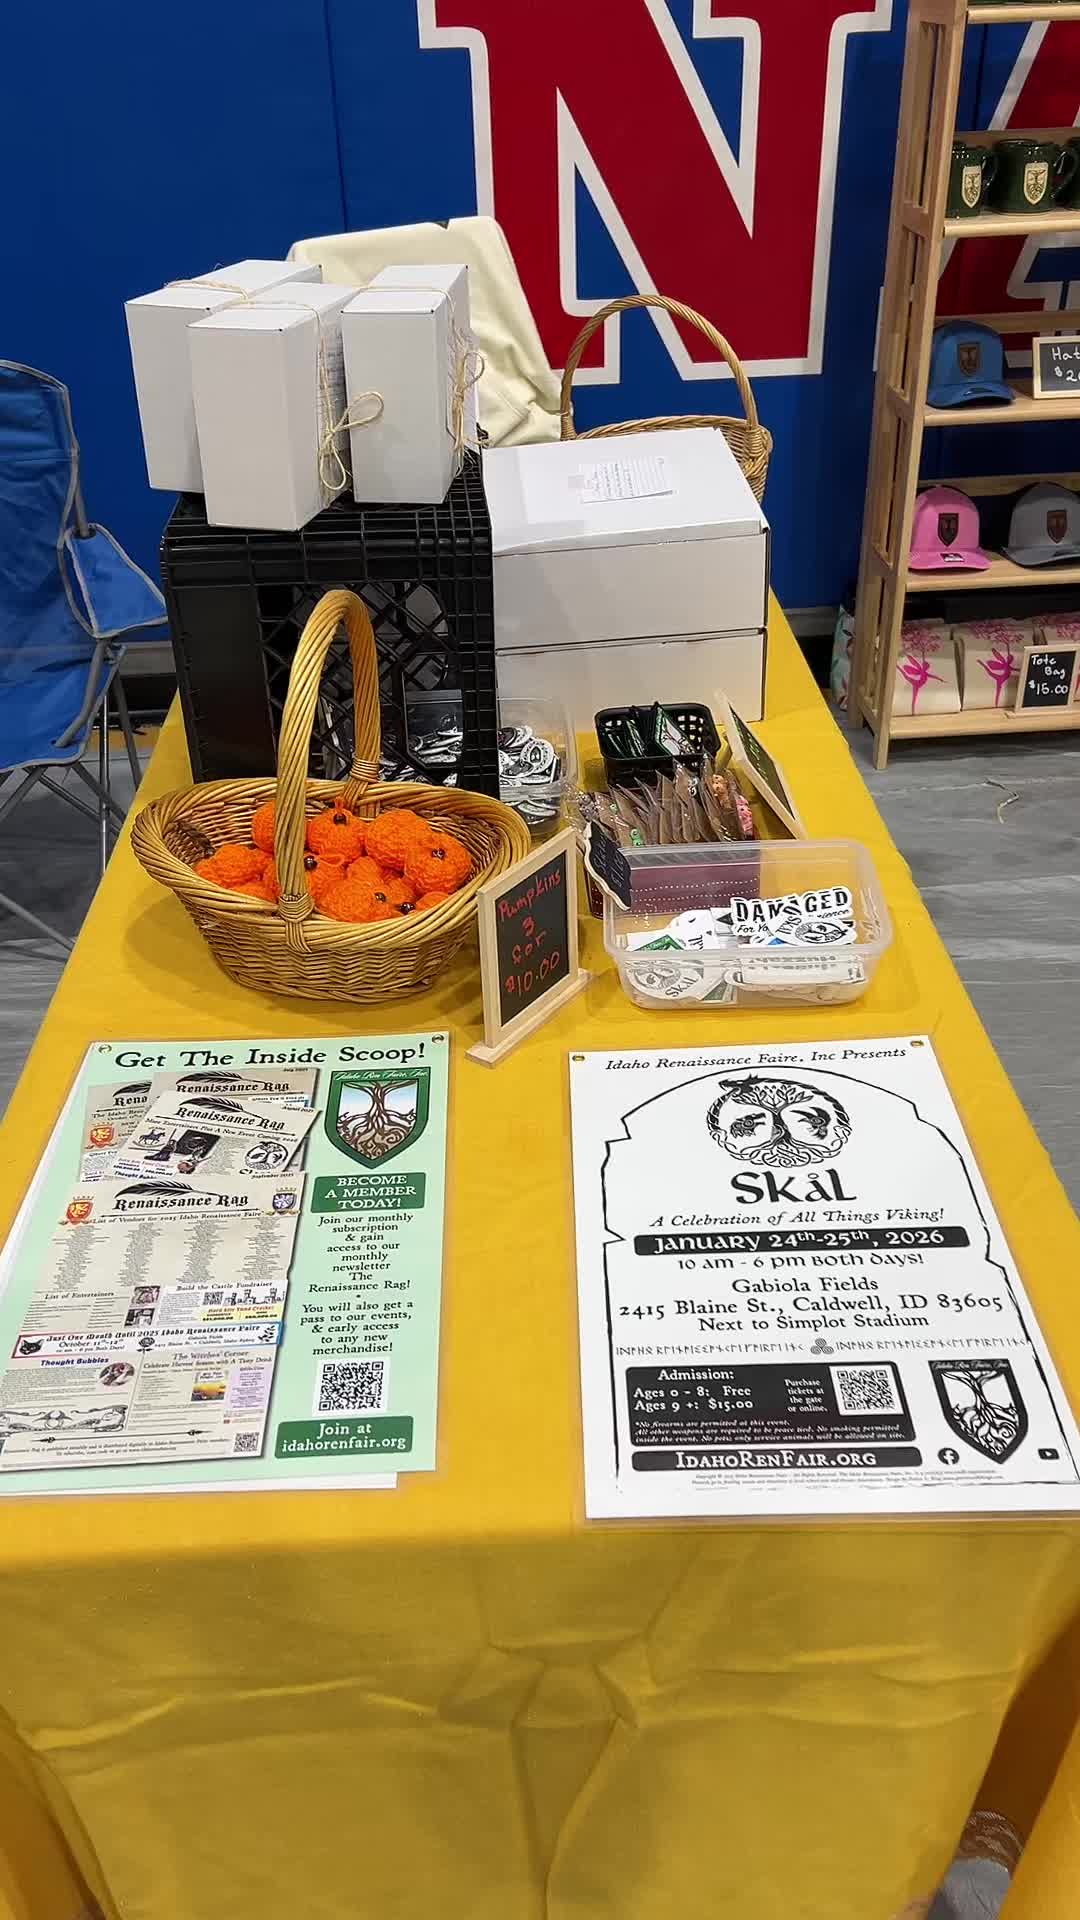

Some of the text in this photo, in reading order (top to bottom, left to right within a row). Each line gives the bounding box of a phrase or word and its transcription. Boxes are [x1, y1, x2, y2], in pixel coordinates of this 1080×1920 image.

[1031, 654, 1057, 665] Tote
[1044, 666, 1066, 680] Bag
[1028, 680, 1069, 695] $15.00
[498, 869, 560, 922] Pumpkins
[735, 889, 848, 923] DAMGED
[522, 916, 535, 937] 3
[737, 924, 755, 933] For
[115, 1043, 426, 1068] Get The Inside Scoop!
[605, 1059, 650, 1071] Idaho
[656, 1055, 752, 1069] Renaissance
[811, 1051, 836, 1061] Inc
[842, 1048, 907, 1060] Presents
[336, 1175, 408, 1187] BECOME
[325, 1186, 417, 1199] A MEMBER
[112, 1194, 249, 1211] Renaissance Rag
[338, 1198, 402, 1210] TODAY!
[318, 1213, 414, 1227] Join our monthly
[649, 1208, 945, 1227] A Celebration of All Things Viking!
[332, 1223, 399, 1234] subscription
[345, 1233, 384, 1243] & gain
[885, 1229, 945, 1246] 2026
[327, 1241, 400, 1252] access to our
[341, 1251, 389, 1262] monthly
[678, 1259, 696, 1270] 10
[701, 1258, 735, 1270] am
[753, 1256, 764, 1268] 6
[771, 1256, 807, 1270] pm
[332, 1262, 391, 1273] newsletter
[349, 1271, 373, 1281] The
[309, 1279, 411, 1293] Renaissance Rag!
[732, 1276, 879, 1293] Gabiola Fields
[302, 1303, 324, 1313] You
[328, 1301, 350, 1312] will
[356, 1300, 379, 1311] also
[383, 1300, 401, 1311] get
[619, 1292, 1003, 1320] 2415 Blaine St., Caldwell, ID 83605
[300, 1310, 412, 1326] pass to our events,
[697, 1312, 930, 1332] Next to Simplot Stadium
[311, 1322, 400, 1334] & early access
[321, 1334, 389, 1345] to any new
[312, 1342, 394, 1356] merchandise!
[657, 1369, 735, 1381] Admission:
[785, 1378, 821, 1387] Purchase
[633, 1387, 665, 1399] Ages
[696, 1386, 711, 1398] 8:
[723, 1385, 752, 1397] Free
[788, 1387, 825, 1396] tickets at
[633, 1401, 666, 1413] Ages
[671, 1402, 681, 1413] 9
[708, 1399, 754, 1412] $15.00
[790, 1395, 823, 1406] the gate
[788, 1404, 829, 1413] or online.
[316, 1422, 373, 1438] Join at
[281, 1433, 407, 1453] idahorenfair.org
